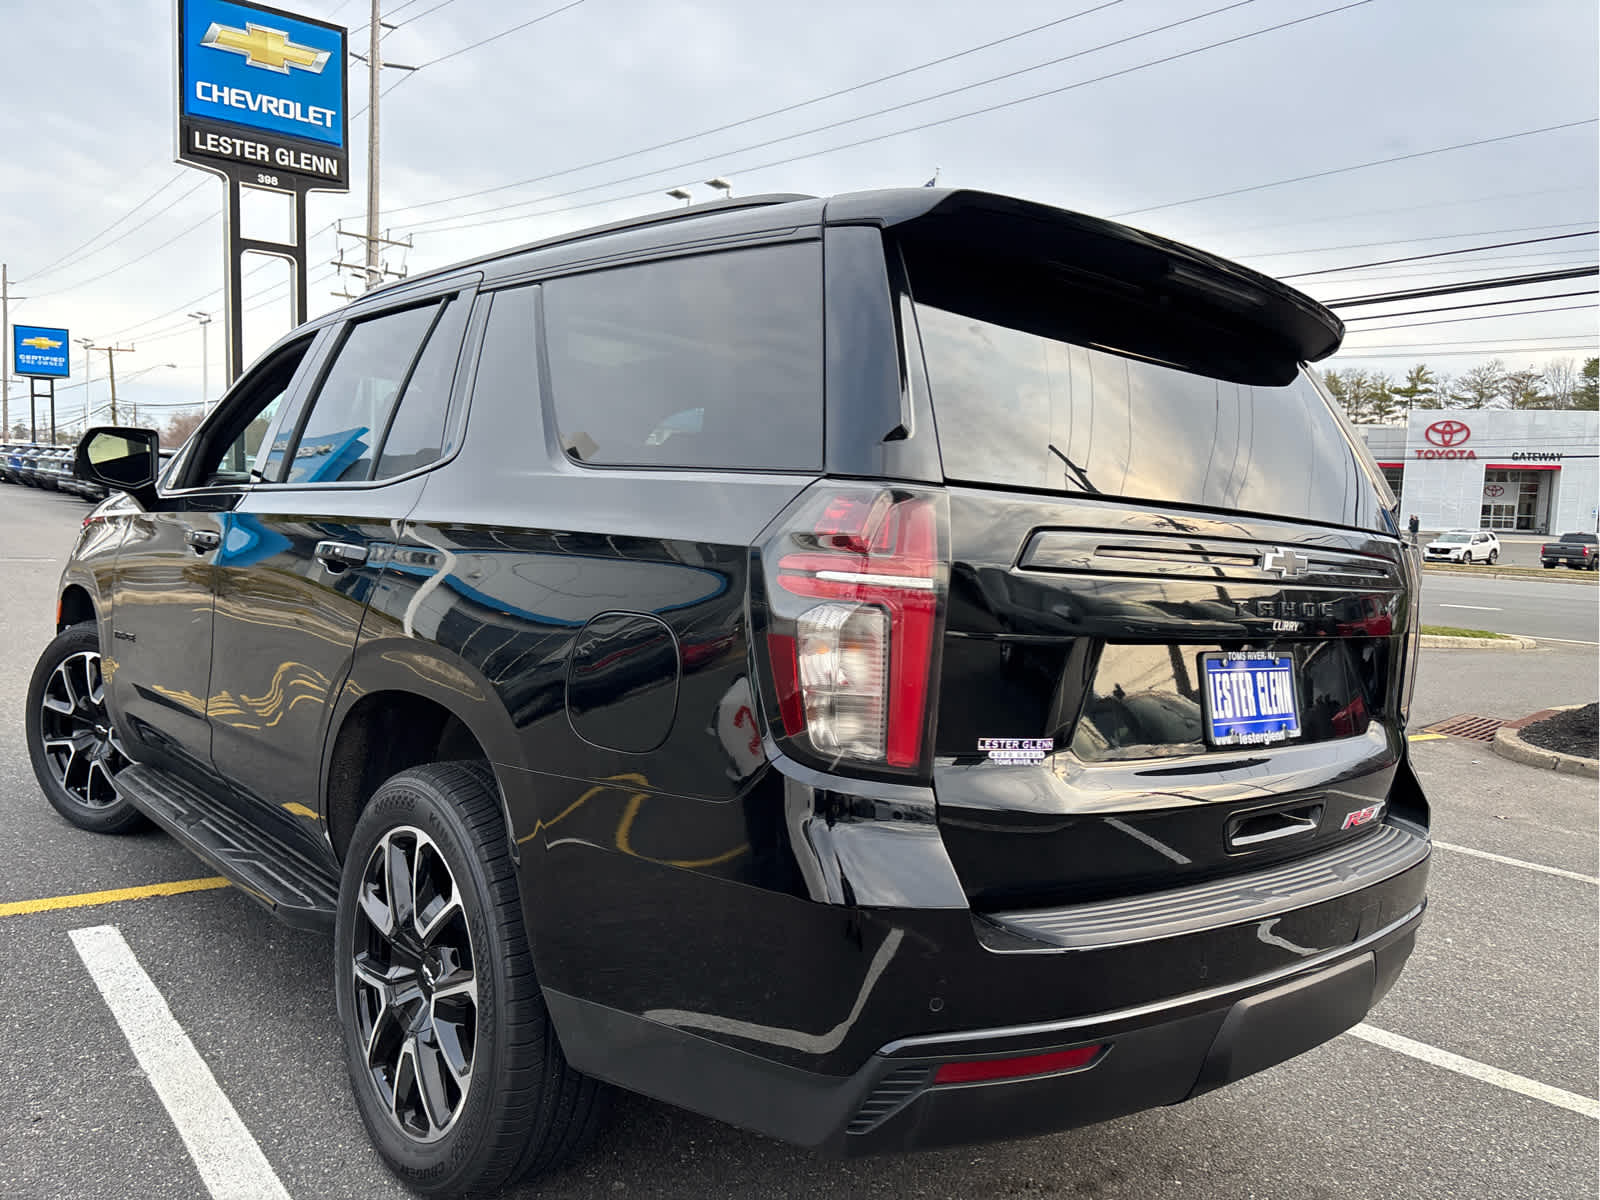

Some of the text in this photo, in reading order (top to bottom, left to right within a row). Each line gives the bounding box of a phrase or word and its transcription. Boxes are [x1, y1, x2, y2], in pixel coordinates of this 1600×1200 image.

[196, 81, 336, 128] CHEVROLET
[195, 131, 338, 176] LESTER GLENN
[257, 174, 278, 186] 398
[19, 354, 65, 363] CERTIFIED
[1415, 450, 1477, 460] TOYOTA
[1511, 451, 1562, 461] GATEWAY
[1272, 620, 1300, 632] CURRY
[1228, 651, 1246, 661] TOMS
[1209, 670, 1294, 719] LESTER GLENN
[978, 740, 1053, 749] LESTER GLENN
[1341, 801, 1385, 829] RS
